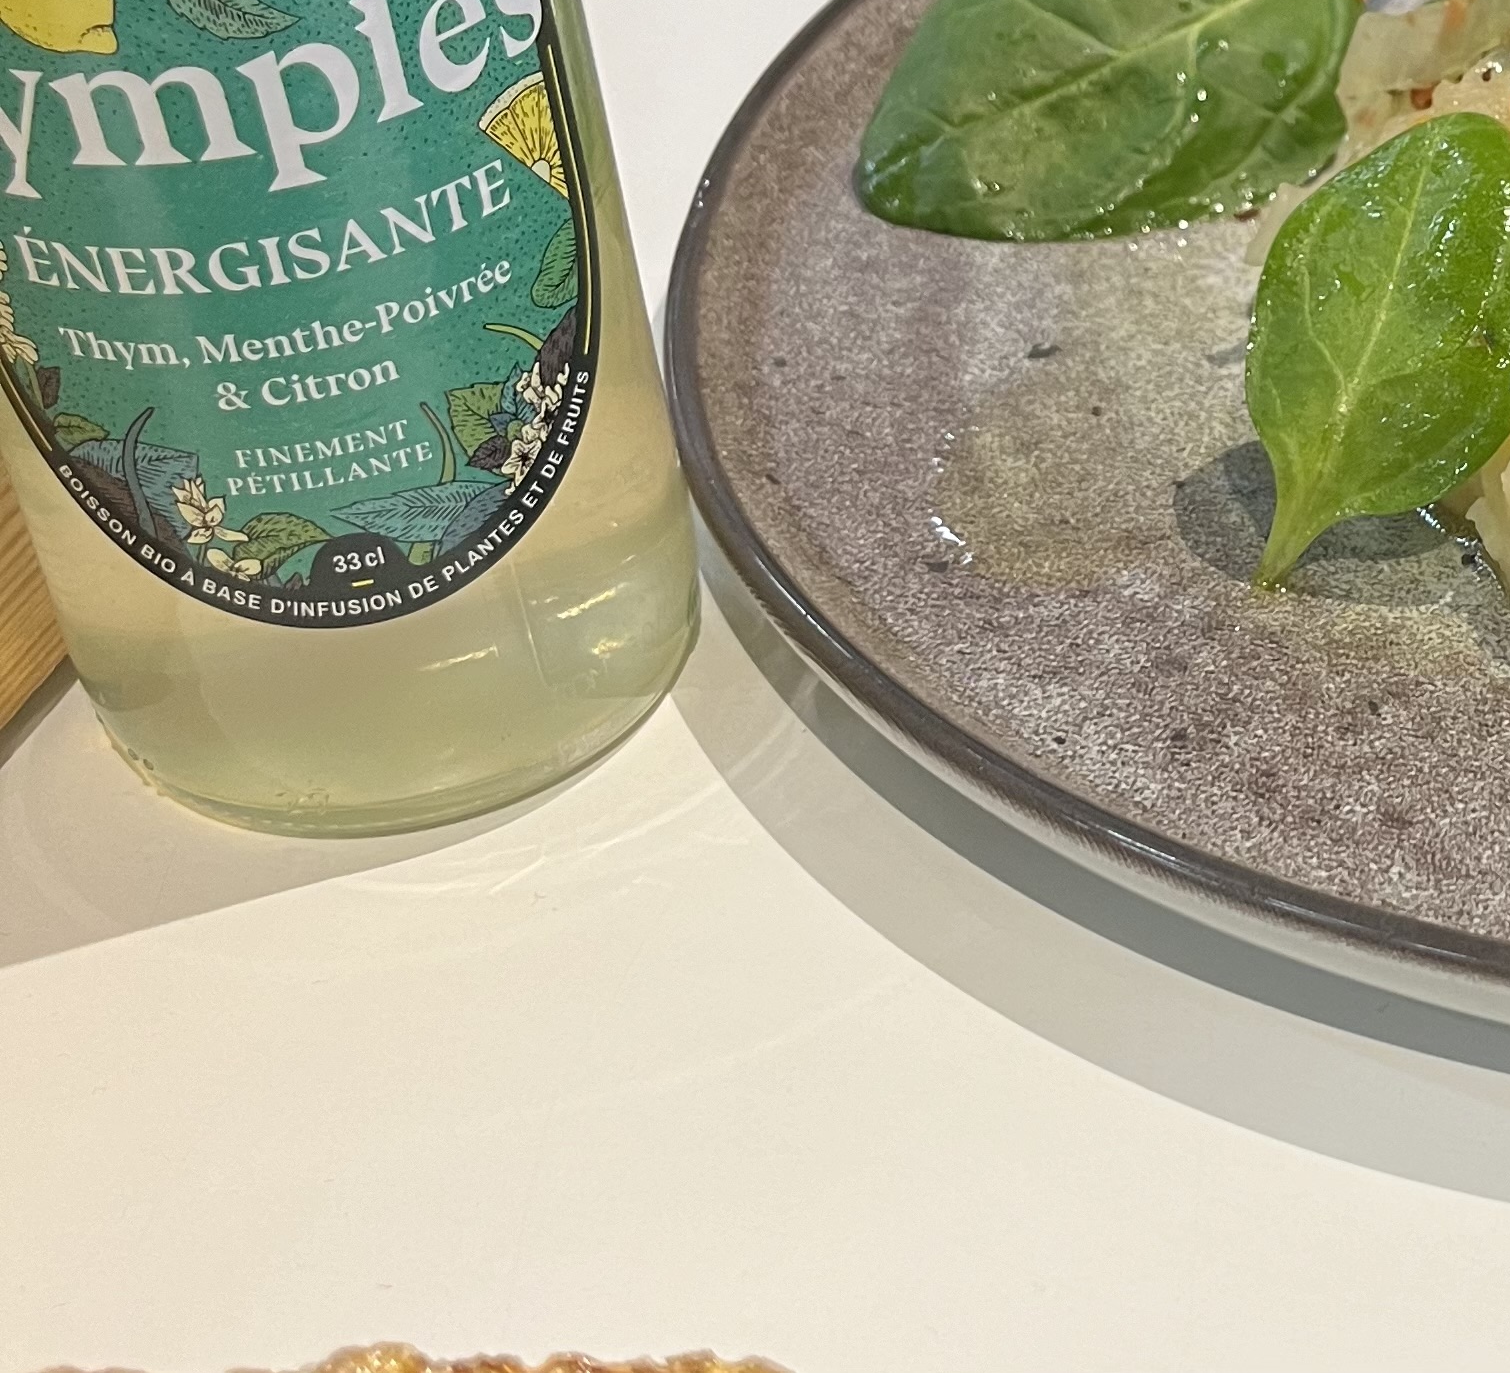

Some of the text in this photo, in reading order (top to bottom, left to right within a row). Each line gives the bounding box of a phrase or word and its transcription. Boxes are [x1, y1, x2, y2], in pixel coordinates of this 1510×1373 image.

[13, 159, 512, 295] ÉNERGISANTE
[58, 259, 512, 370] Thym, Menthe-Poivrée
[216, 359, 400, 411] & Citron
[227, 441, 433, 496] PÉTILLANTE
[235, 419, 408, 468] FINEMENT
[59, 370, 590, 617] BOISSON BIO À BASE D'INFUSION DE PLANTES ET DE FRUITS
